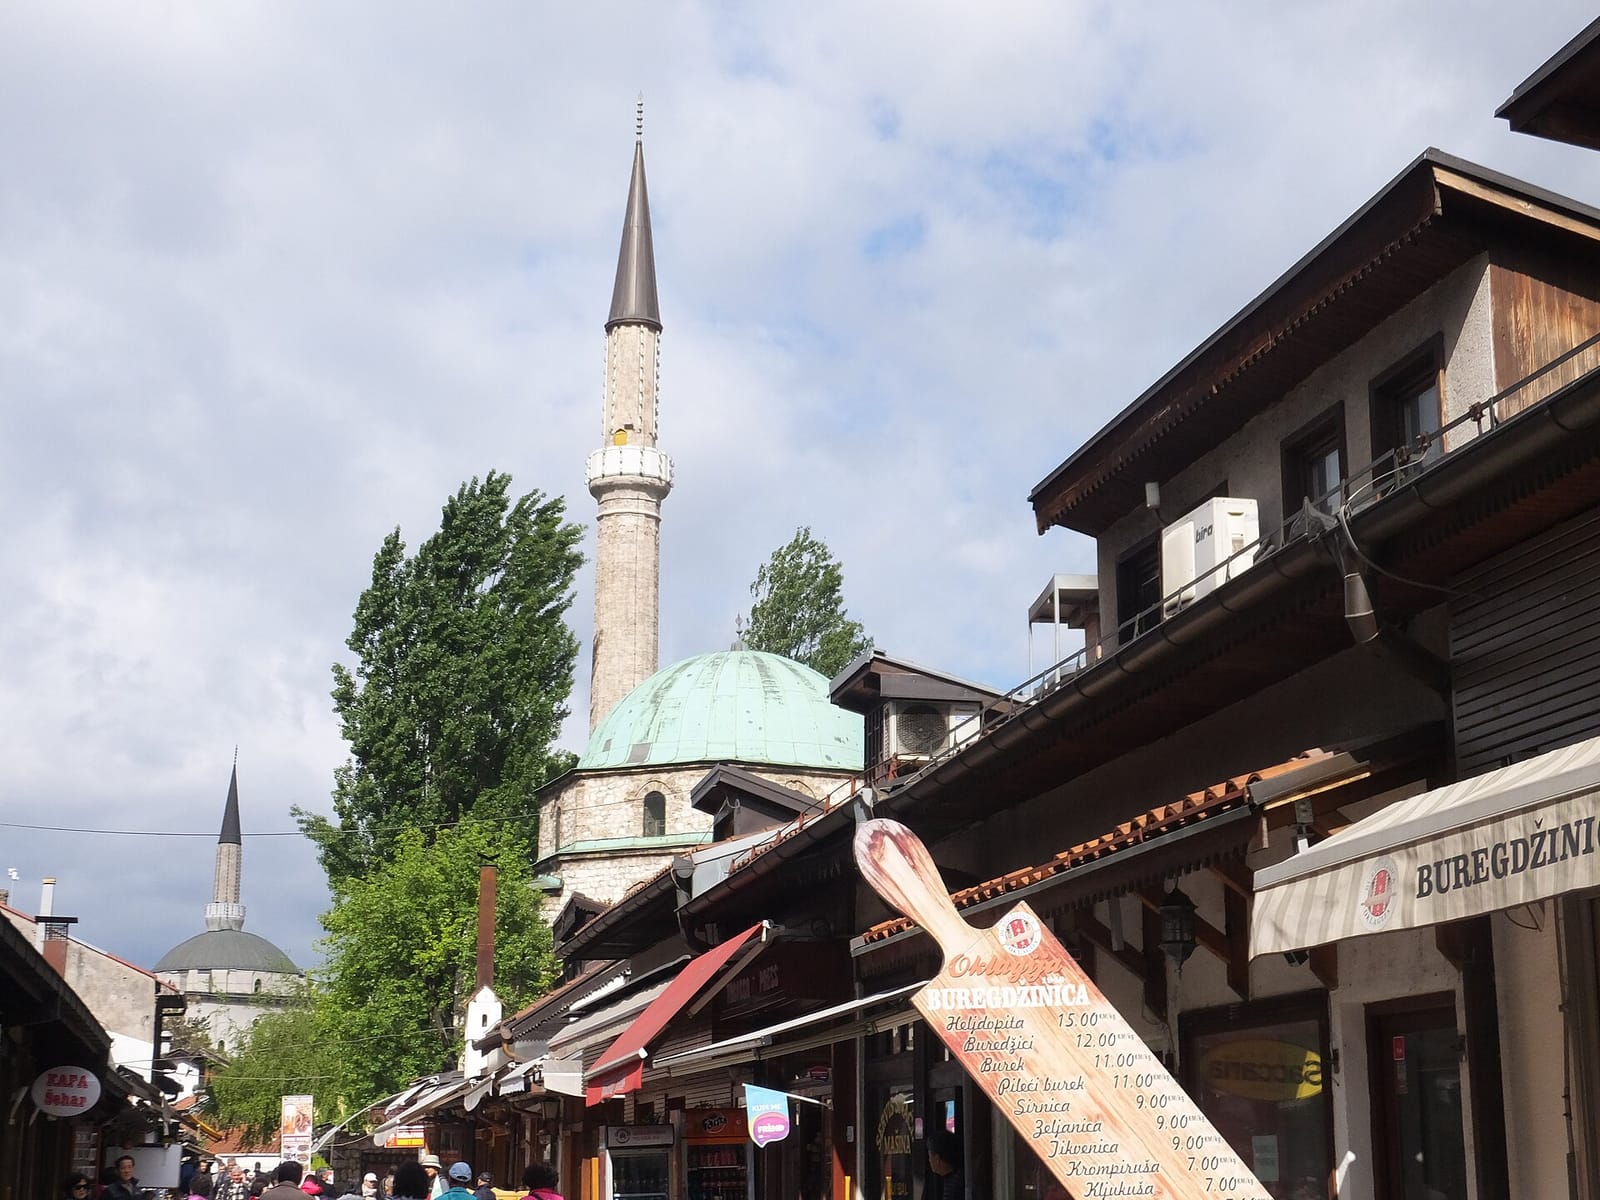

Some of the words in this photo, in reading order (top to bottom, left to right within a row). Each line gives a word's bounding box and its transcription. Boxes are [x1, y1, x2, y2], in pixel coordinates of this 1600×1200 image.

[1415, 815, 1600, 899] BUREGDŽINI
[948, 953, 1064, 984] Oklagija
[927, 978, 1090, 1011] BUREGDŽINICA
[946, 1015, 1025, 1035] Heljdopita
[1058, 1012, 1099, 1028] 15.00
[963, 1035, 1034, 1055] Buredžici
[1076, 1032, 1117, 1048] 12.00
[980, 1057, 1025, 1073] Burek
[1095, 1053, 1135, 1068] 11.00
[998, 1077, 1040, 1096] Pileći
[1043, 1075, 1085, 1092] burek
[1113, 1073, 1153, 1089] 11.00
[1014, 1097, 1071, 1116] Sirnica
[1136, 1094, 1168, 1109] 9.00
[702, 1116, 728, 1131] Fanta
[1032, 1118, 1102, 1139] Zeljanica
[1156, 1114, 1188, 1130] 9.00
[1048, 1138, 1119, 1159] Tikvenica
[1172, 1135, 1204, 1151] 9.00
[1066, 1160, 1161, 1179] Krompiruša
[1188, 1156, 1219, 1172] 7.00
[1083, 1180, 1155, 1200] Kljukuša
[1205, 1176, 1237, 1192] 7.00
